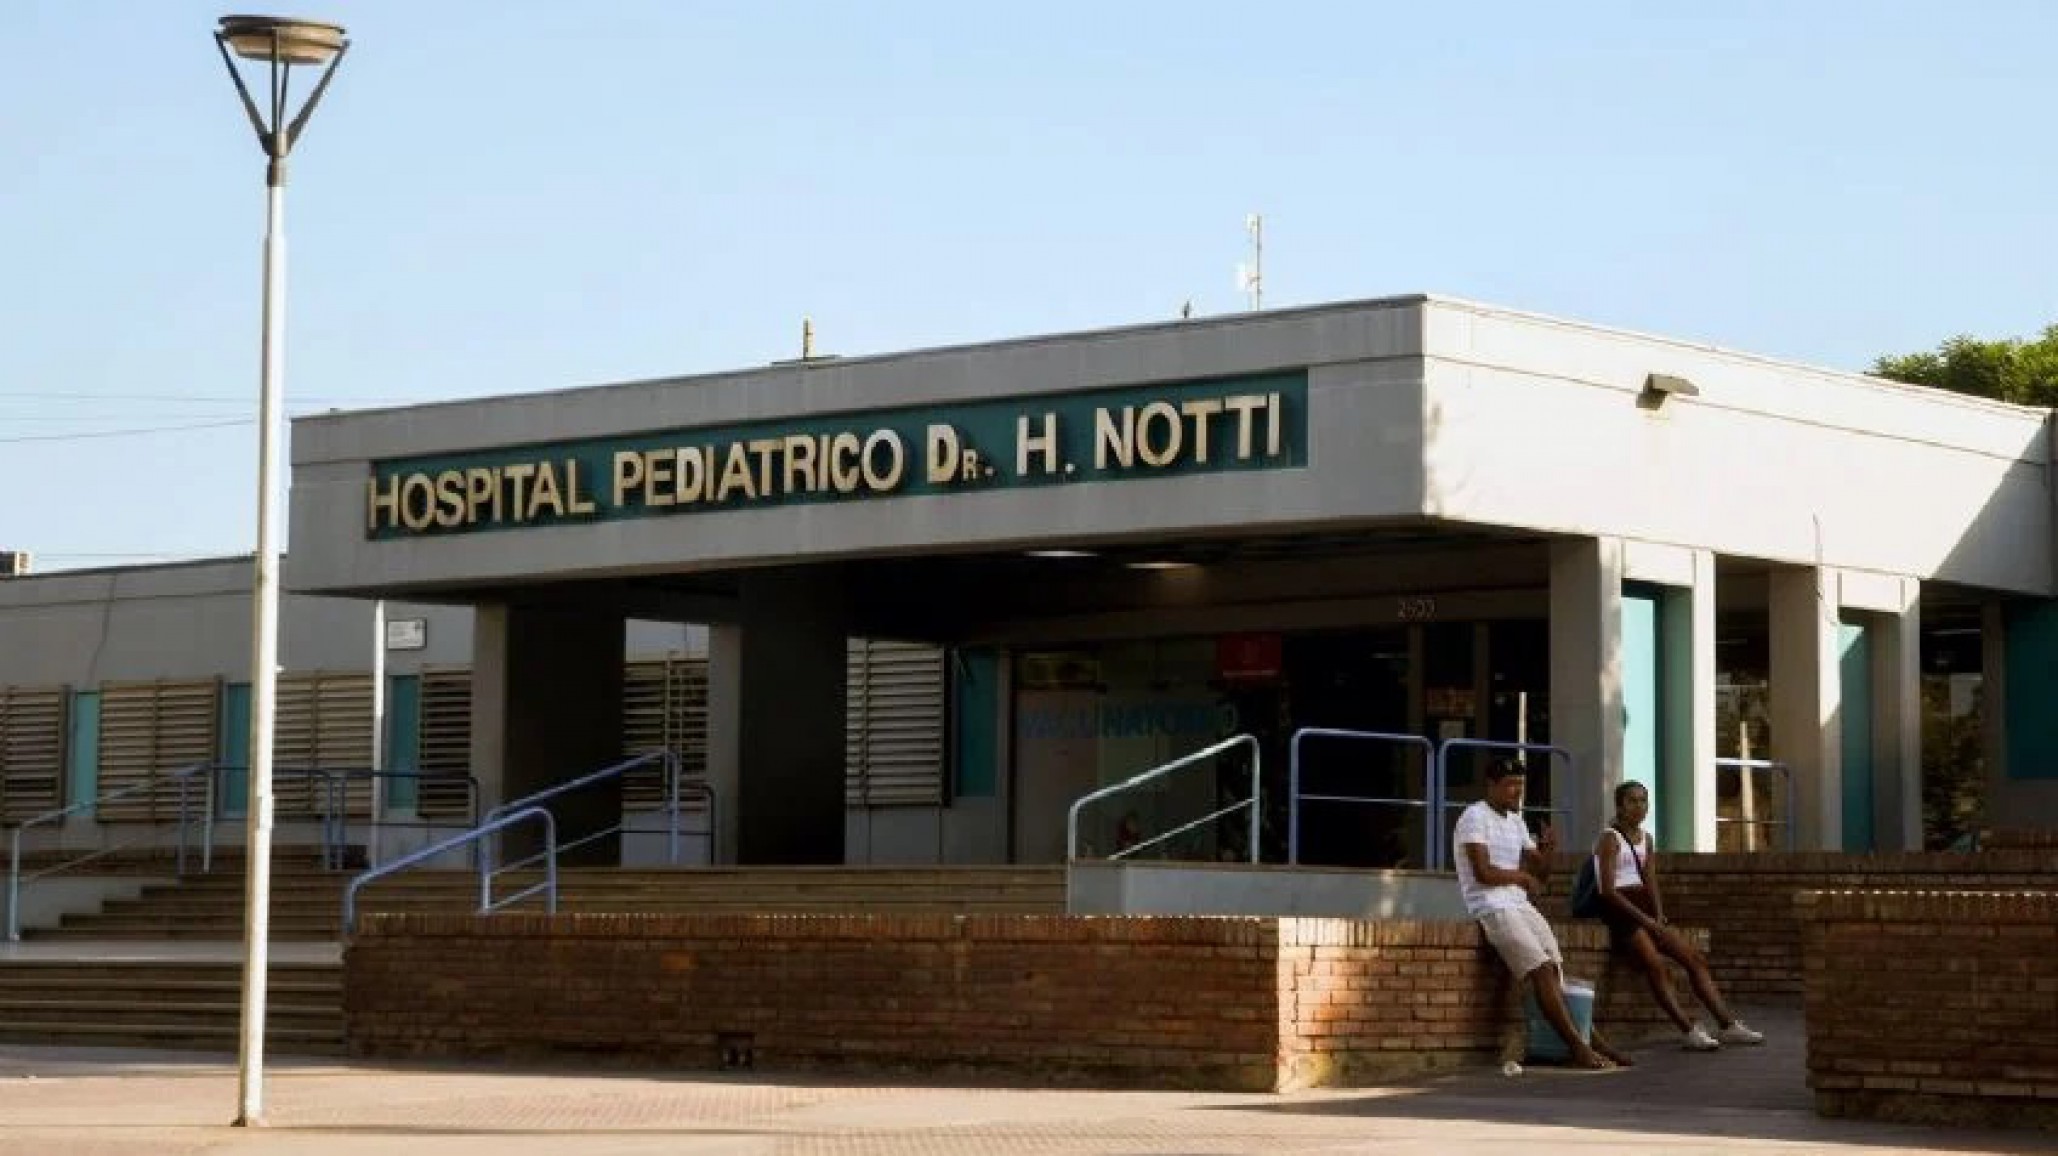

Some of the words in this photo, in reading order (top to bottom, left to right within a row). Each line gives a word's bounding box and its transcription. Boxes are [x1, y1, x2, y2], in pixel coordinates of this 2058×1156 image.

[369, 459, 595, 530] HOSPITAL
[613, 429, 903, 506] PEDIATRICO
[1016, 411, 1076, 477] H.
[1094, 392, 1281, 469] NOTTI
